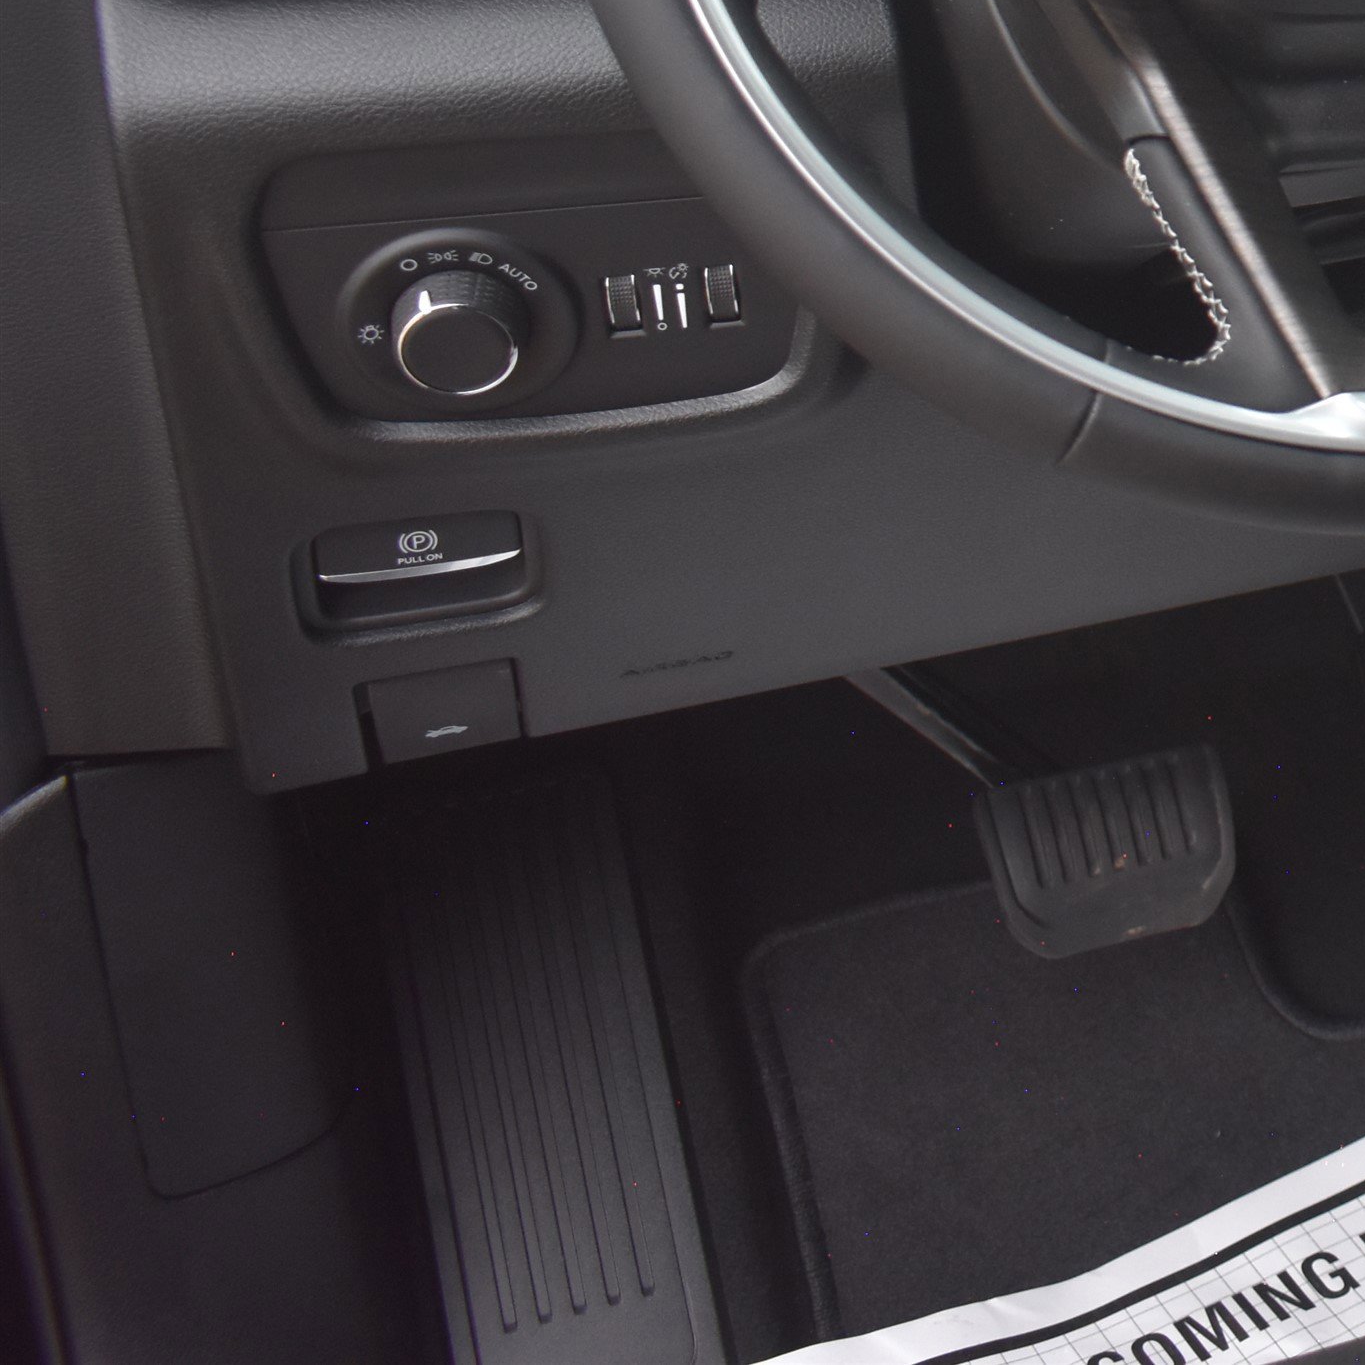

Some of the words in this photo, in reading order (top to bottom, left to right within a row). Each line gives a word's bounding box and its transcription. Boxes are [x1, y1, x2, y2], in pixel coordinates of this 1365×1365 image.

[498, 262, 538, 291] AUTO
[397, 554, 424, 565] PULL
[425, 552, 443, 563] ON
